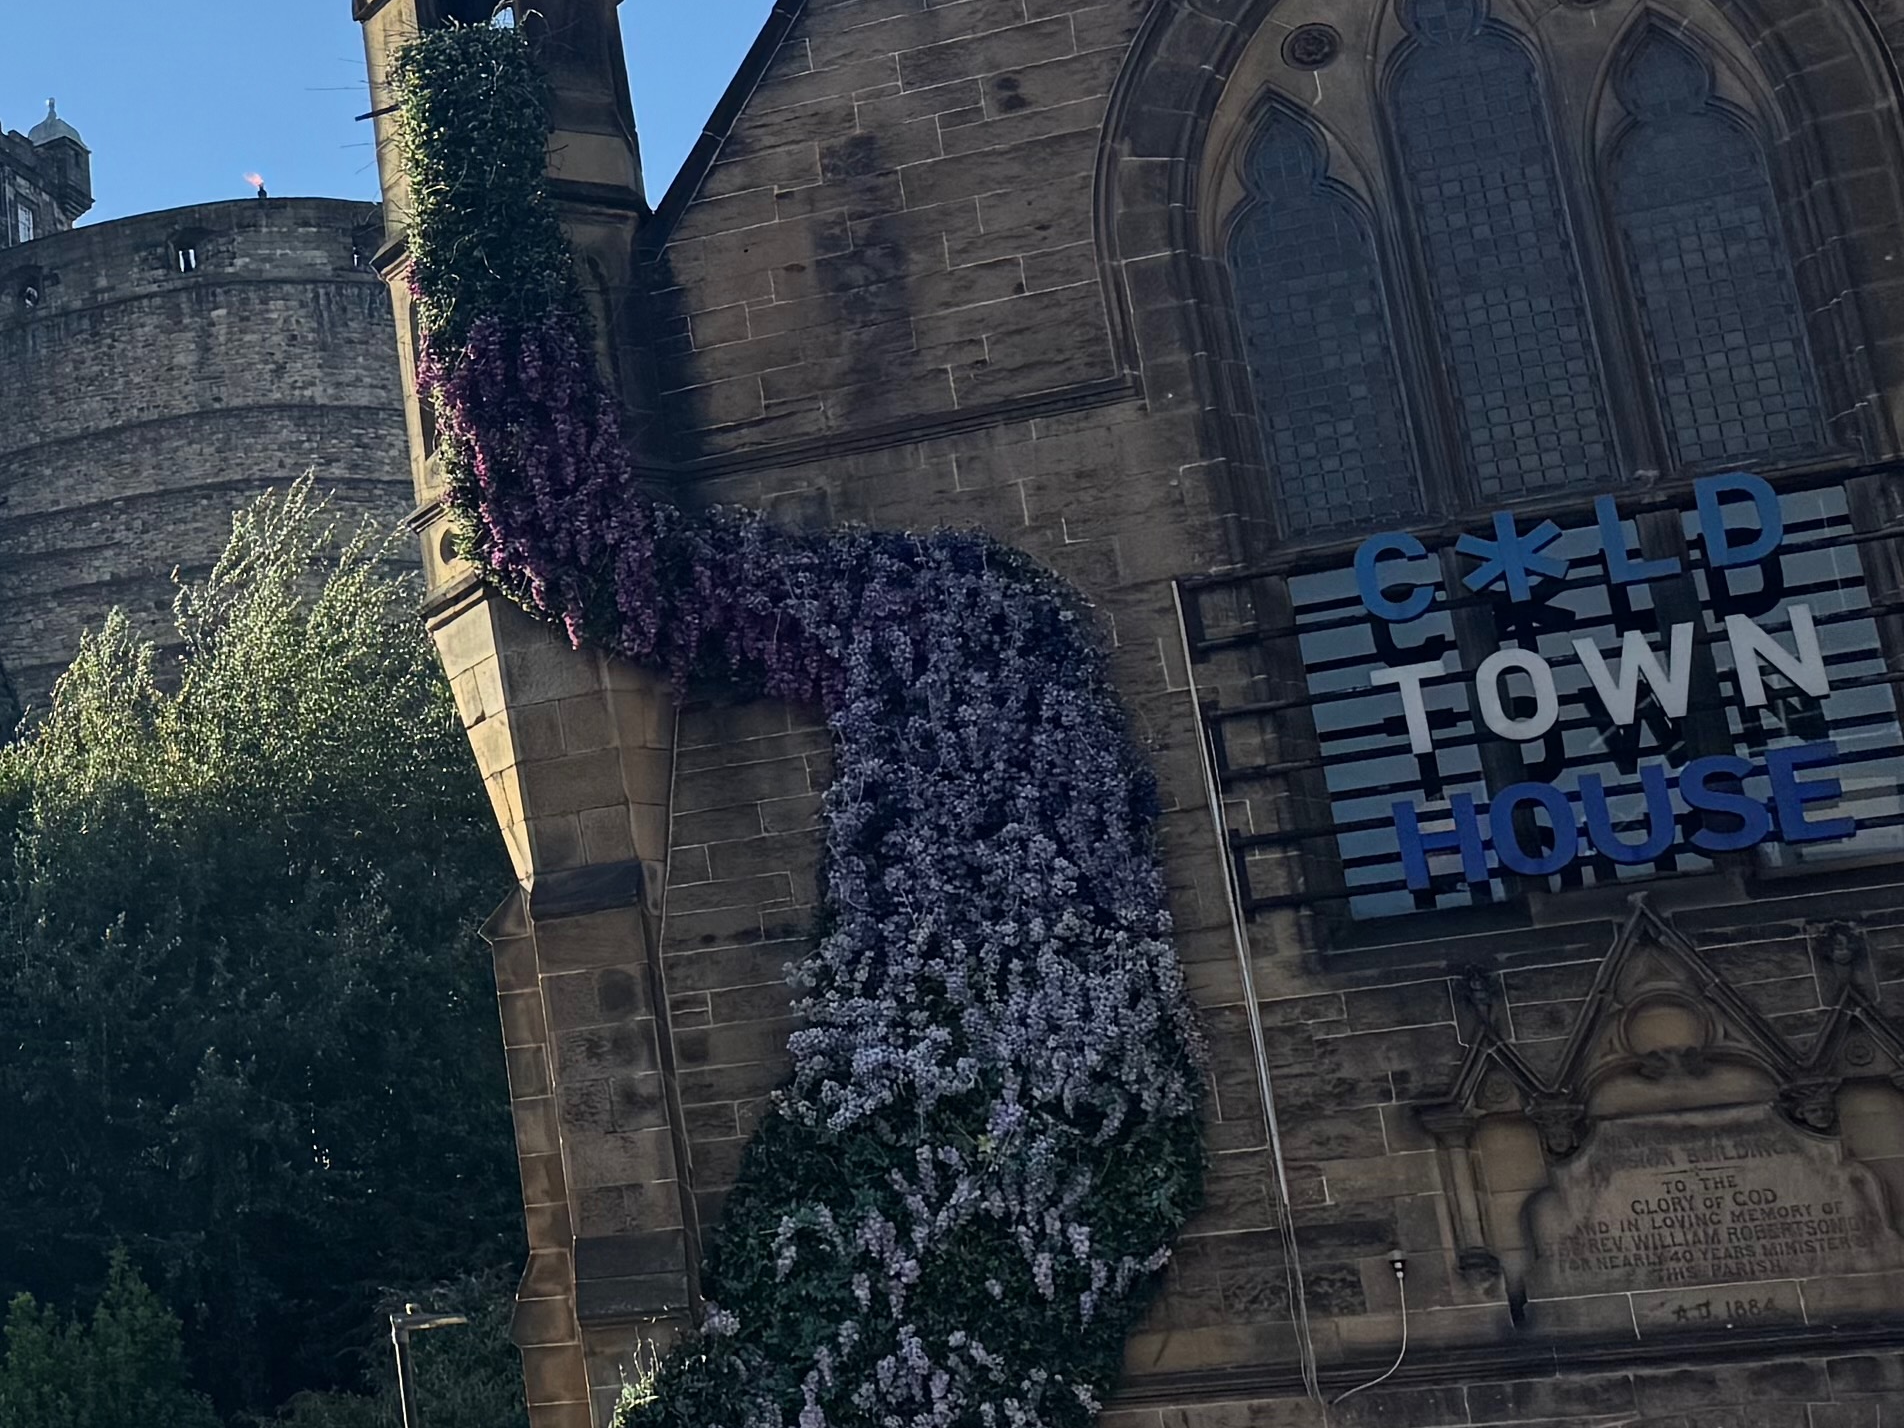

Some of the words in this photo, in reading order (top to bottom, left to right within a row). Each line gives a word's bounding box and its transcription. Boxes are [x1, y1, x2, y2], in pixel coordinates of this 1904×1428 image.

[1369, 604, 1832, 755] TOWN
[1392, 740, 1857, 892] HOUSE
[1661, 1179, 1686, 1195] TO
[1698, 1175, 1739, 1191] THE
[1630, 1195, 1694, 1216] GLORY
[1703, 1196, 1725, 1210] OF
[1732, 1188, 1778, 1207] GOD
[1620, 1217, 1641, 1233] IN
[1651, 1212, 1722, 1231] LOVING
[1729, 1203, 1813, 1224] MEMORY
[1631, 1227, 1721, 1251] WILLIAM
[1596, 1249, 1666, 1270] NEARLY
[1668, 1248, 1694, 1264] 40
[1698, 1242, 1756, 1261] YEARS
